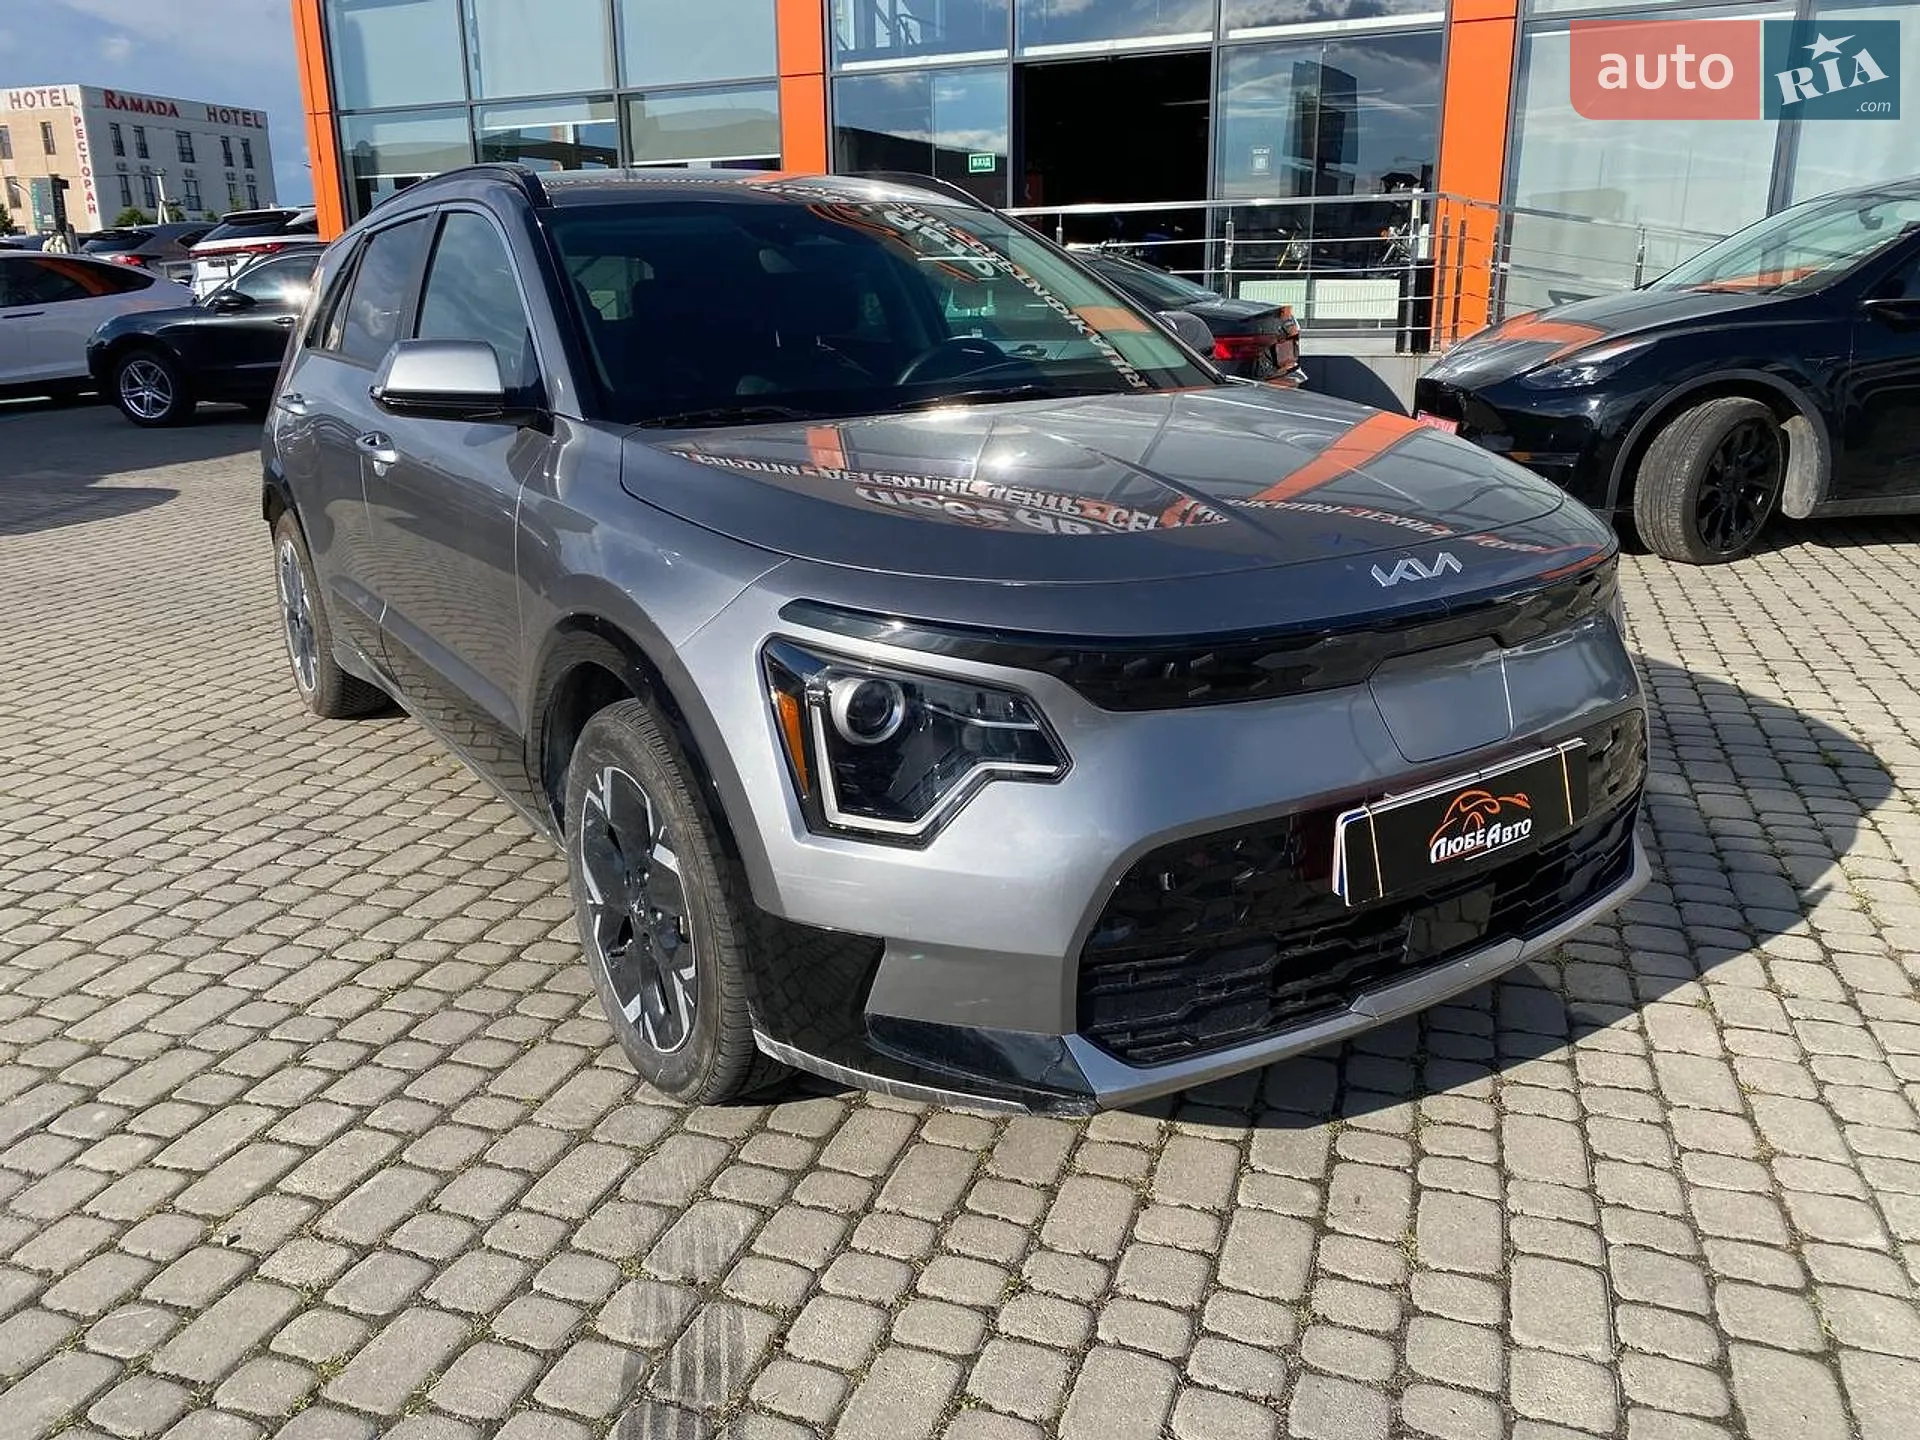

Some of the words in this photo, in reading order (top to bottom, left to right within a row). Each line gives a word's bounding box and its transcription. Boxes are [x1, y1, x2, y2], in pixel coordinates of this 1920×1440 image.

[9, 88, 75, 110] HOTEL
[104, 90, 180, 118] RAMADA
[206, 107, 263, 129] HOTEL
[73, 116, 96, 214] РЕСТОРАН
[1371, 552, 1463, 588] KIA
